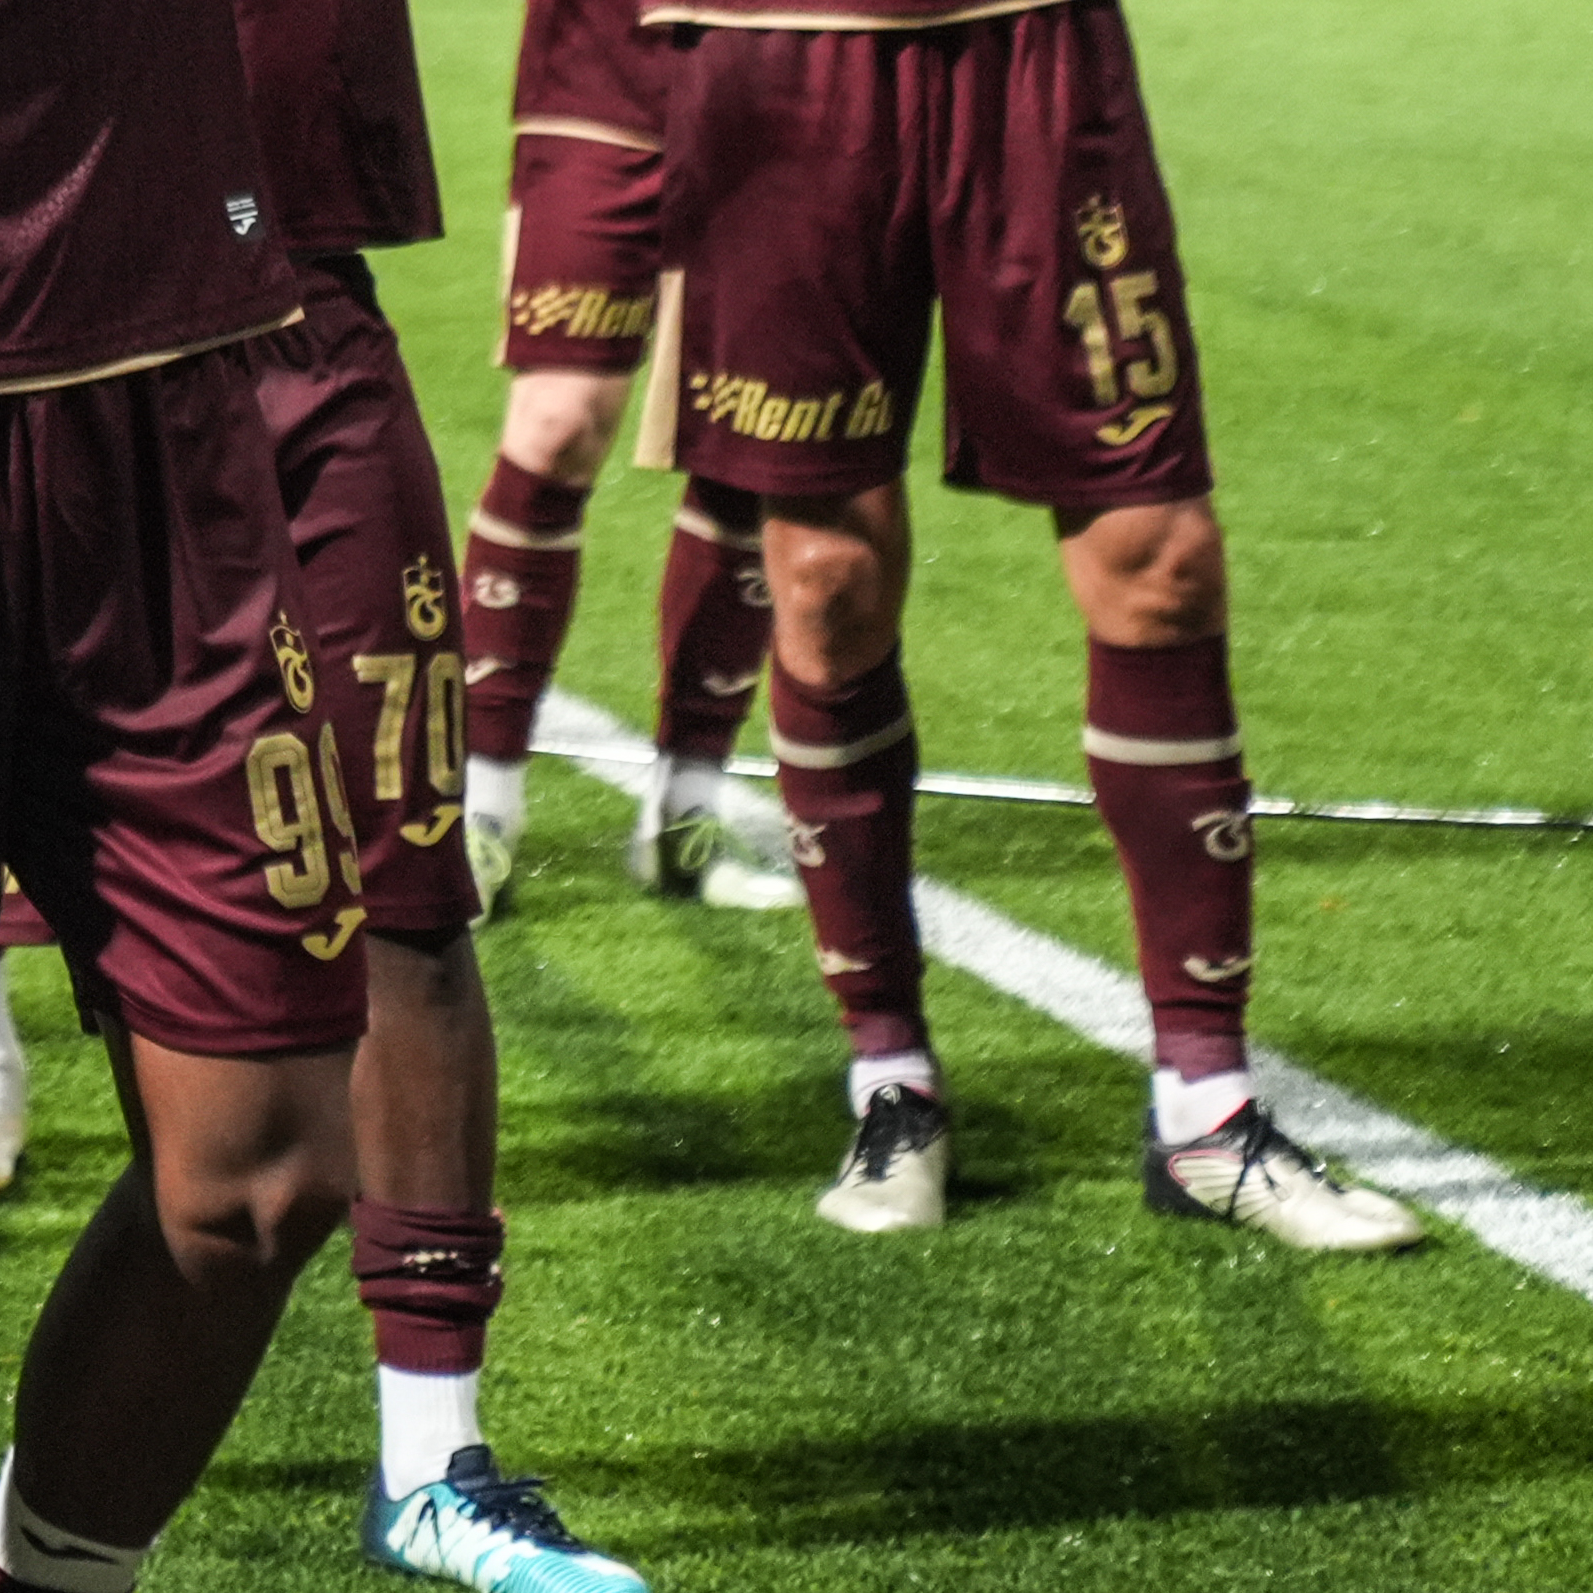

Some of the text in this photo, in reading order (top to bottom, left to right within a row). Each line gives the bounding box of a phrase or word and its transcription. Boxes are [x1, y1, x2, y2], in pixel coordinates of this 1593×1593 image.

[1065, 271, 1179, 405] 15
[733, 378, 842, 443] Rent
[352, 653, 463, 800] 70
